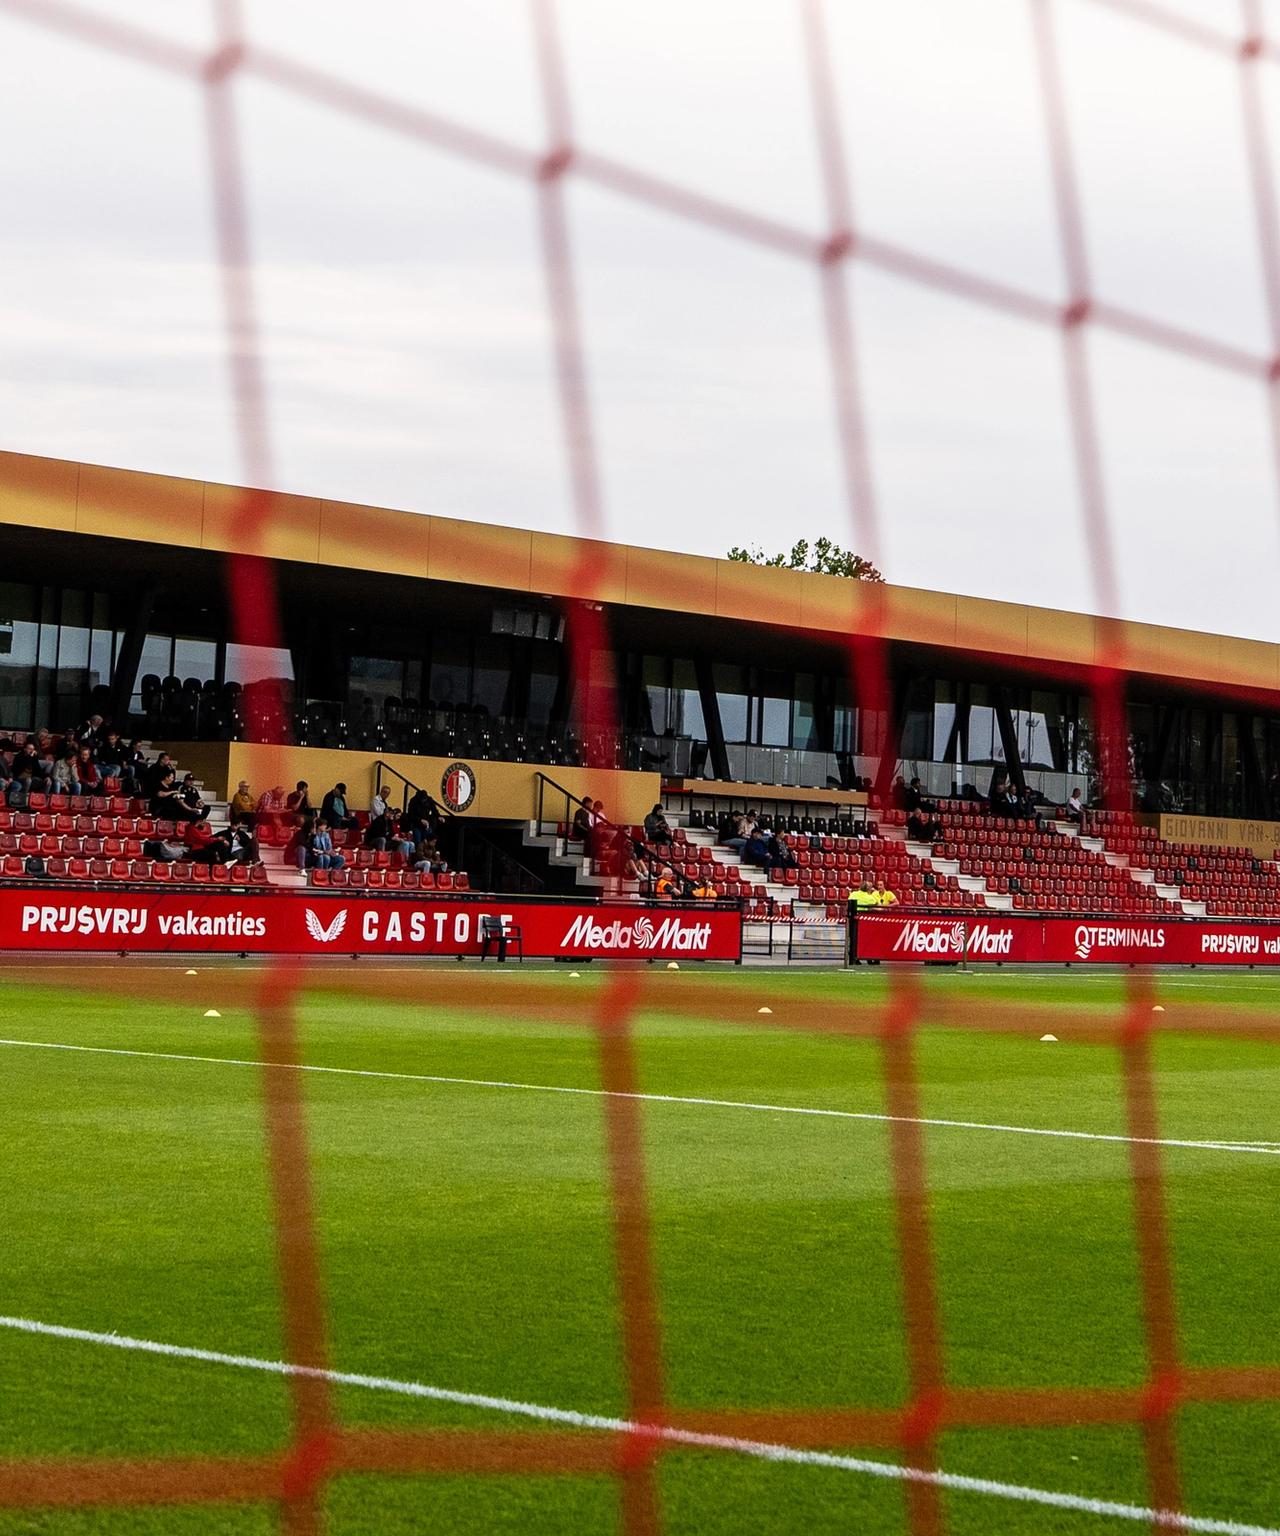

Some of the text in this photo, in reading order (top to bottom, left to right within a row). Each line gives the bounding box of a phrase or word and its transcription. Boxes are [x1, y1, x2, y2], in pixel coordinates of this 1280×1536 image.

[1165, 818, 1229, 840] GIOVANNI
[1239, 823, 1264, 842] VAN
[157, 909, 266, 937] vakanties
